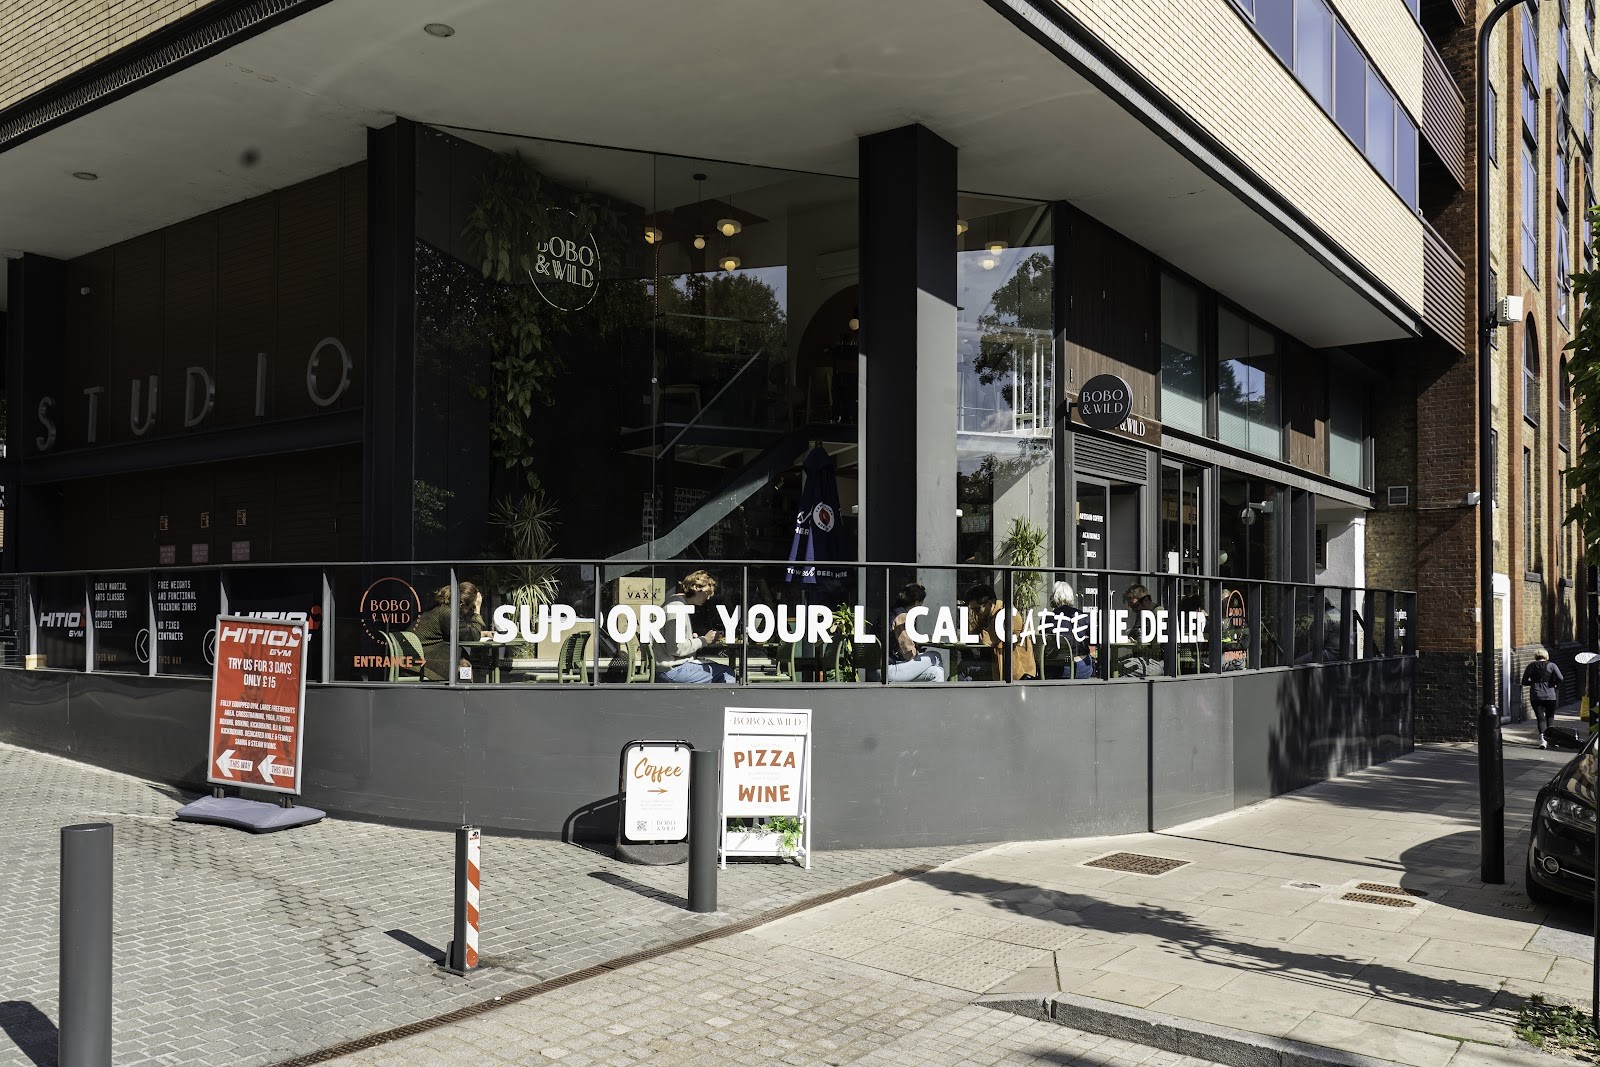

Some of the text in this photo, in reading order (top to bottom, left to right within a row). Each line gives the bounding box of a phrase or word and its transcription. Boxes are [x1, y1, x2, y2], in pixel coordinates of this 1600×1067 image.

[535, 254, 594, 288] & WILD
[35, 336, 354, 452] STUDIO
[1082, 389, 1124, 403] BOBO
[1082, 402, 1123, 415] & WILD
[157, 580, 191, 590] FREE WEIGHTS
[94, 592, 125, 601] ARTS CLASSES
[157, 591, 197, 600] AND FUNCTIONAL
[157, 602, 197, 612] TRAINING ZONES
[370, 599, 411, 612] BOBO
[94, 610, 128, 619] GROUP FITNESS
[381, 612, 411, 624] WILD
[94, 620, 113, 629] CLASSES
[157, 621, 180, 630] NO FIXED
[493, 603, 695, 644] SUPORT
[715, 603, 834, 644] YOUR
[1140, 609, 1207, 643] DELER
[68, 629, 84, 639] GYM
[157, 631, 184, 641] CONTRACTS
[269, 648, 292, 657] GYM
[228, 657, 292, 675] TRY US FOR 3 DAYS
[353, 655, 413, 668] ENTRANCE
[243, 673, 276, 688] ONLY £15
[733, 716, 766, 726] BOBO
[767, 717, 775, 726] &
[229, 758, 252, 770] THIS WAY
[733, 749, 797, 769] PIZZA
[271, 763, 293, 776] THIS WAY
[633, 756, 684, 783] Coffee
[738, 783, 791, 803] WINE
